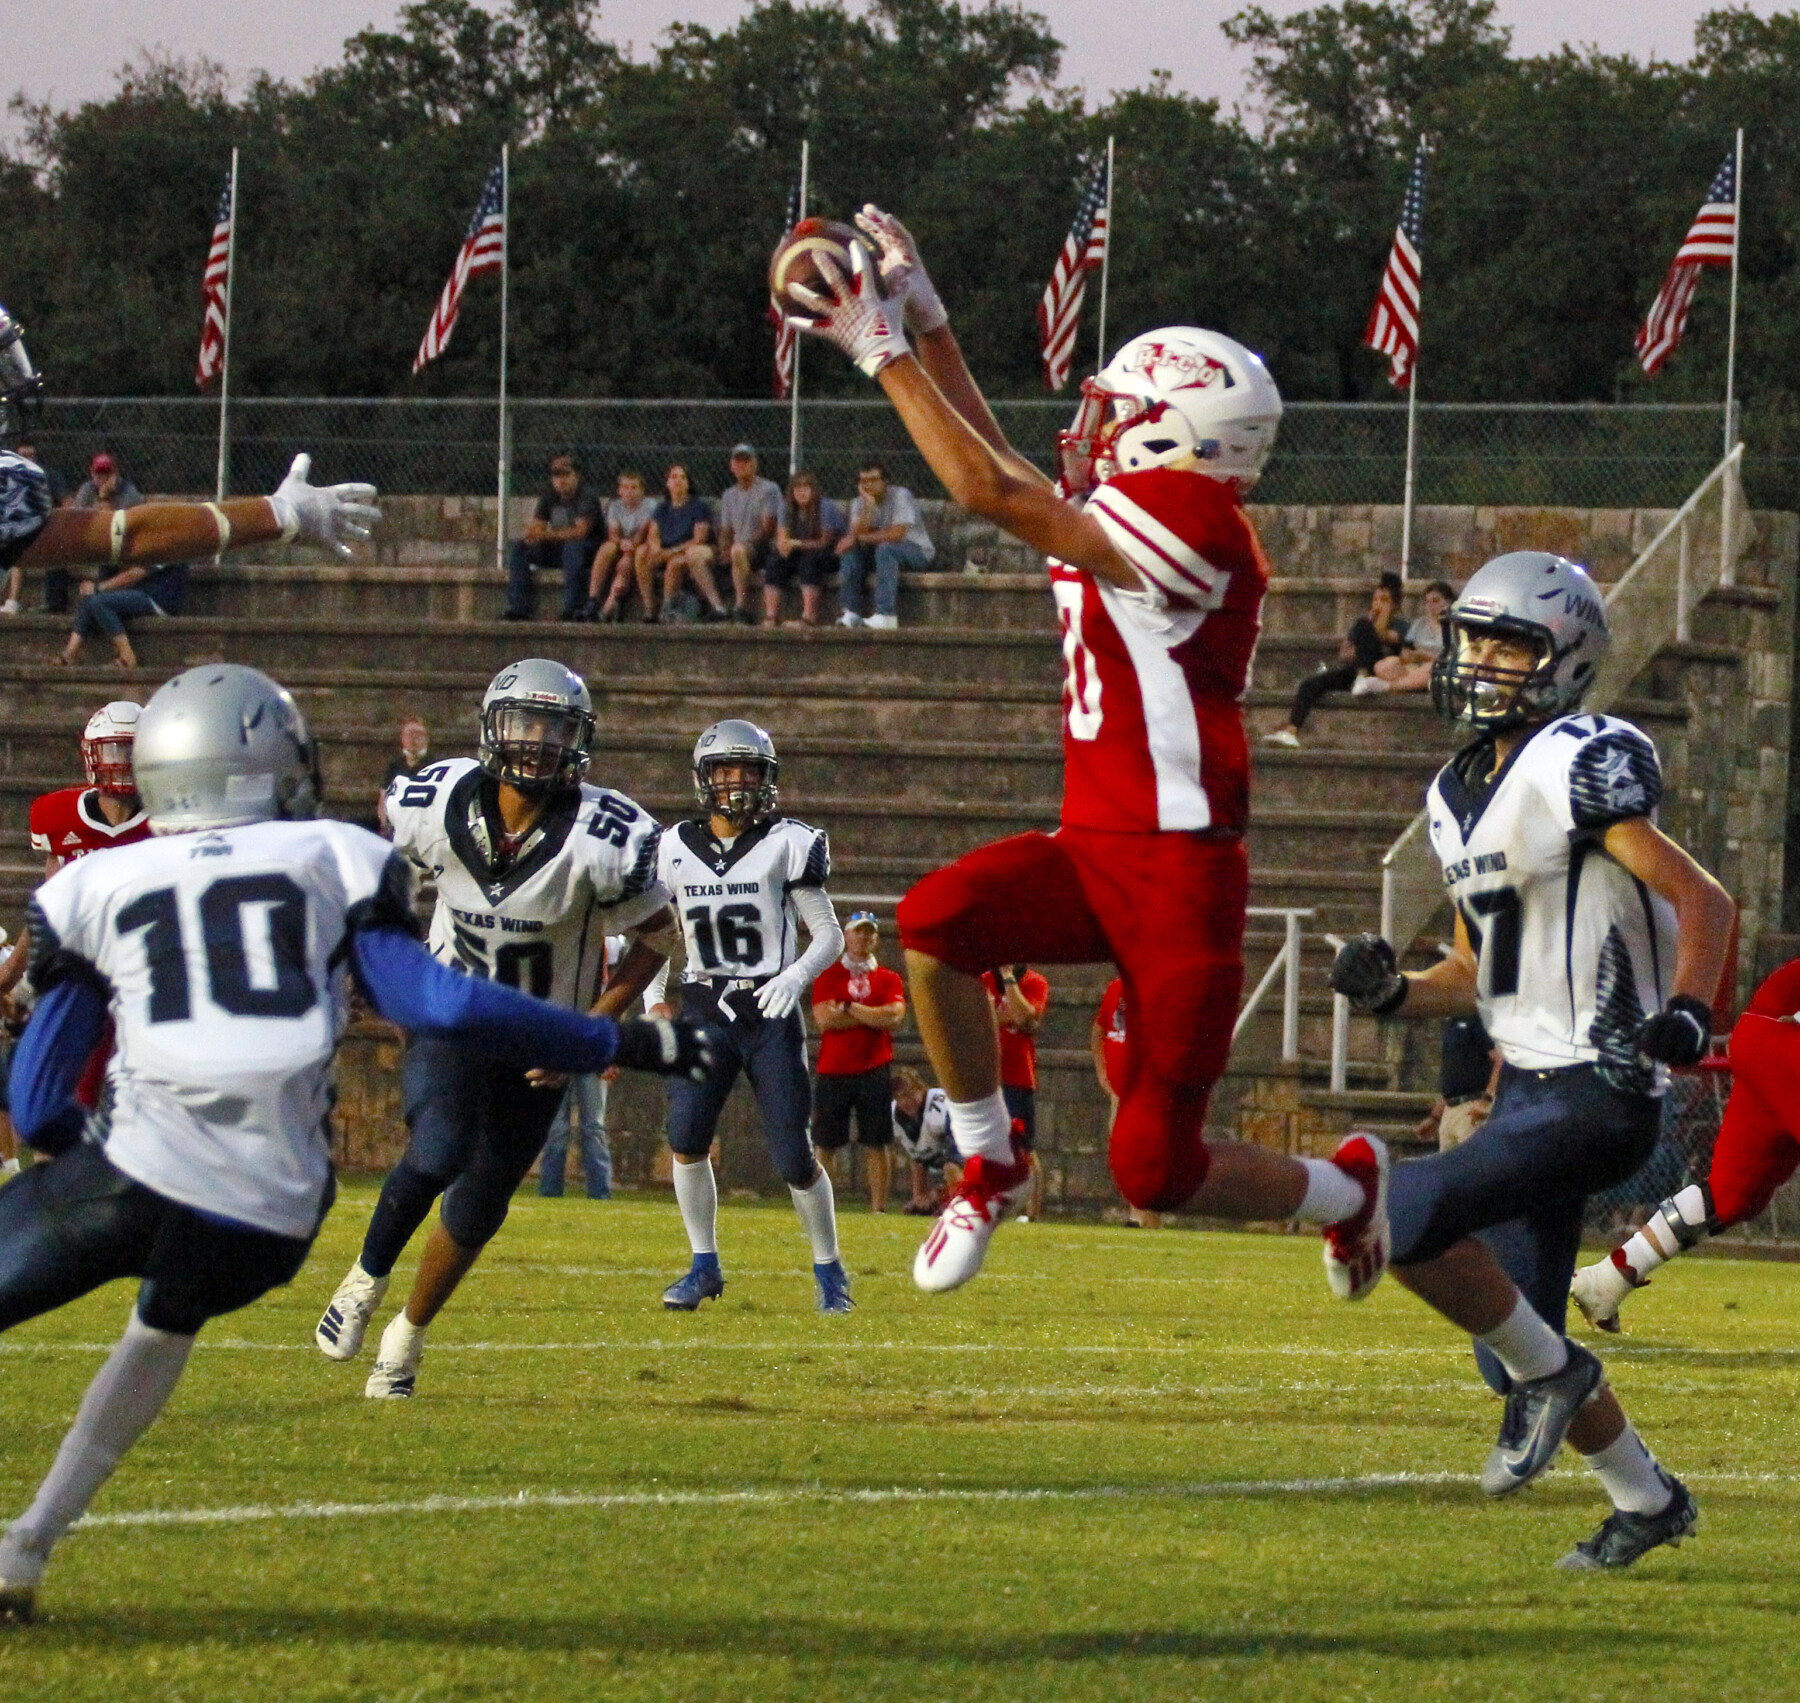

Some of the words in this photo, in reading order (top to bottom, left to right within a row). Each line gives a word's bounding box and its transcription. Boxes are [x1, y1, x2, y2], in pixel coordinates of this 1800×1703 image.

[399, 766, 450, 808] 50
[587, 795, 639, 849] 50
[1473, 850, 1508, 875] WIND
[684, 884, 723, 897] TEXAS
[726, 882, 759, 895] WIND
[500, 915, 544, 932] WIND
[686, 902, 764, 970] 16
[115, 872, 319, 1024] 10
